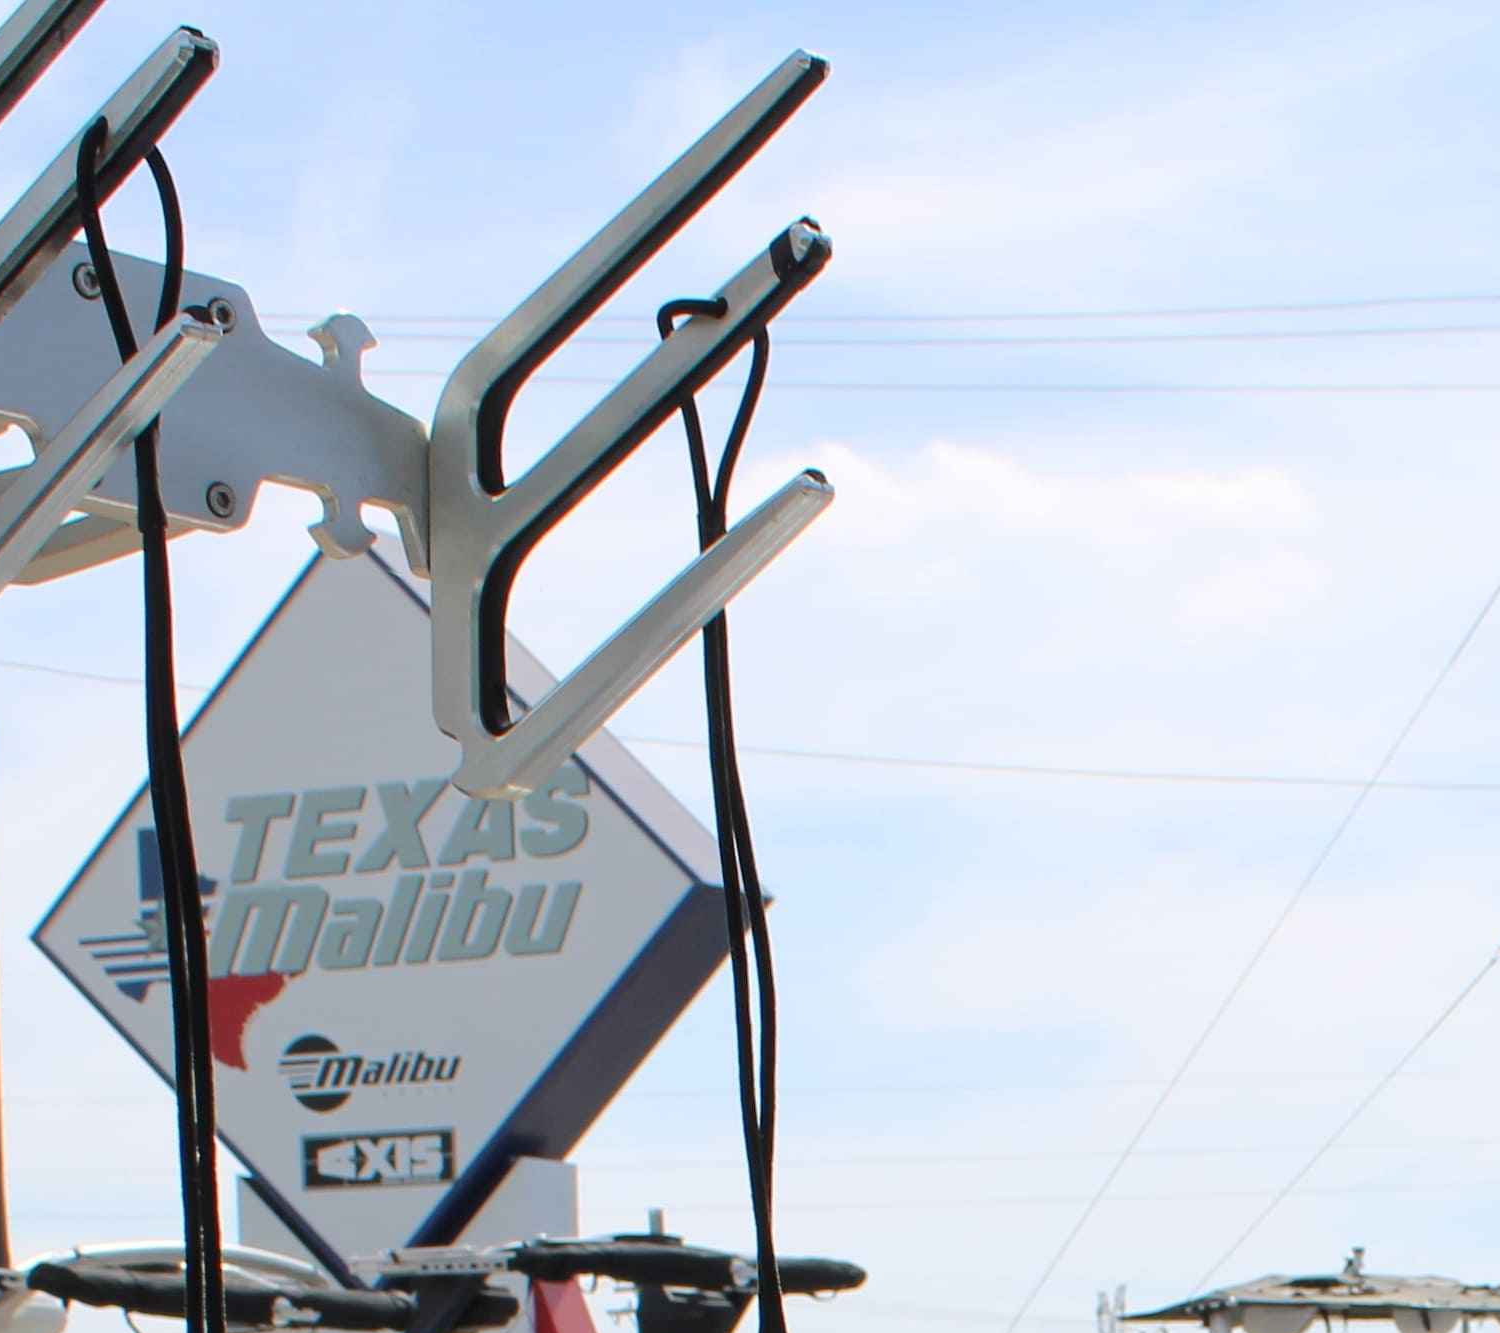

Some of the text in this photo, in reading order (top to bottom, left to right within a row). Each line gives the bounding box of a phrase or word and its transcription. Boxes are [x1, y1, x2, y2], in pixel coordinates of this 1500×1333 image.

[222, 764, 591, 884] TEXAS
[206, 871, 585, 978] Malibu
[315, 1051, 463, 1088] Malibu
[316, 1134, 444, 1180] AXIS
